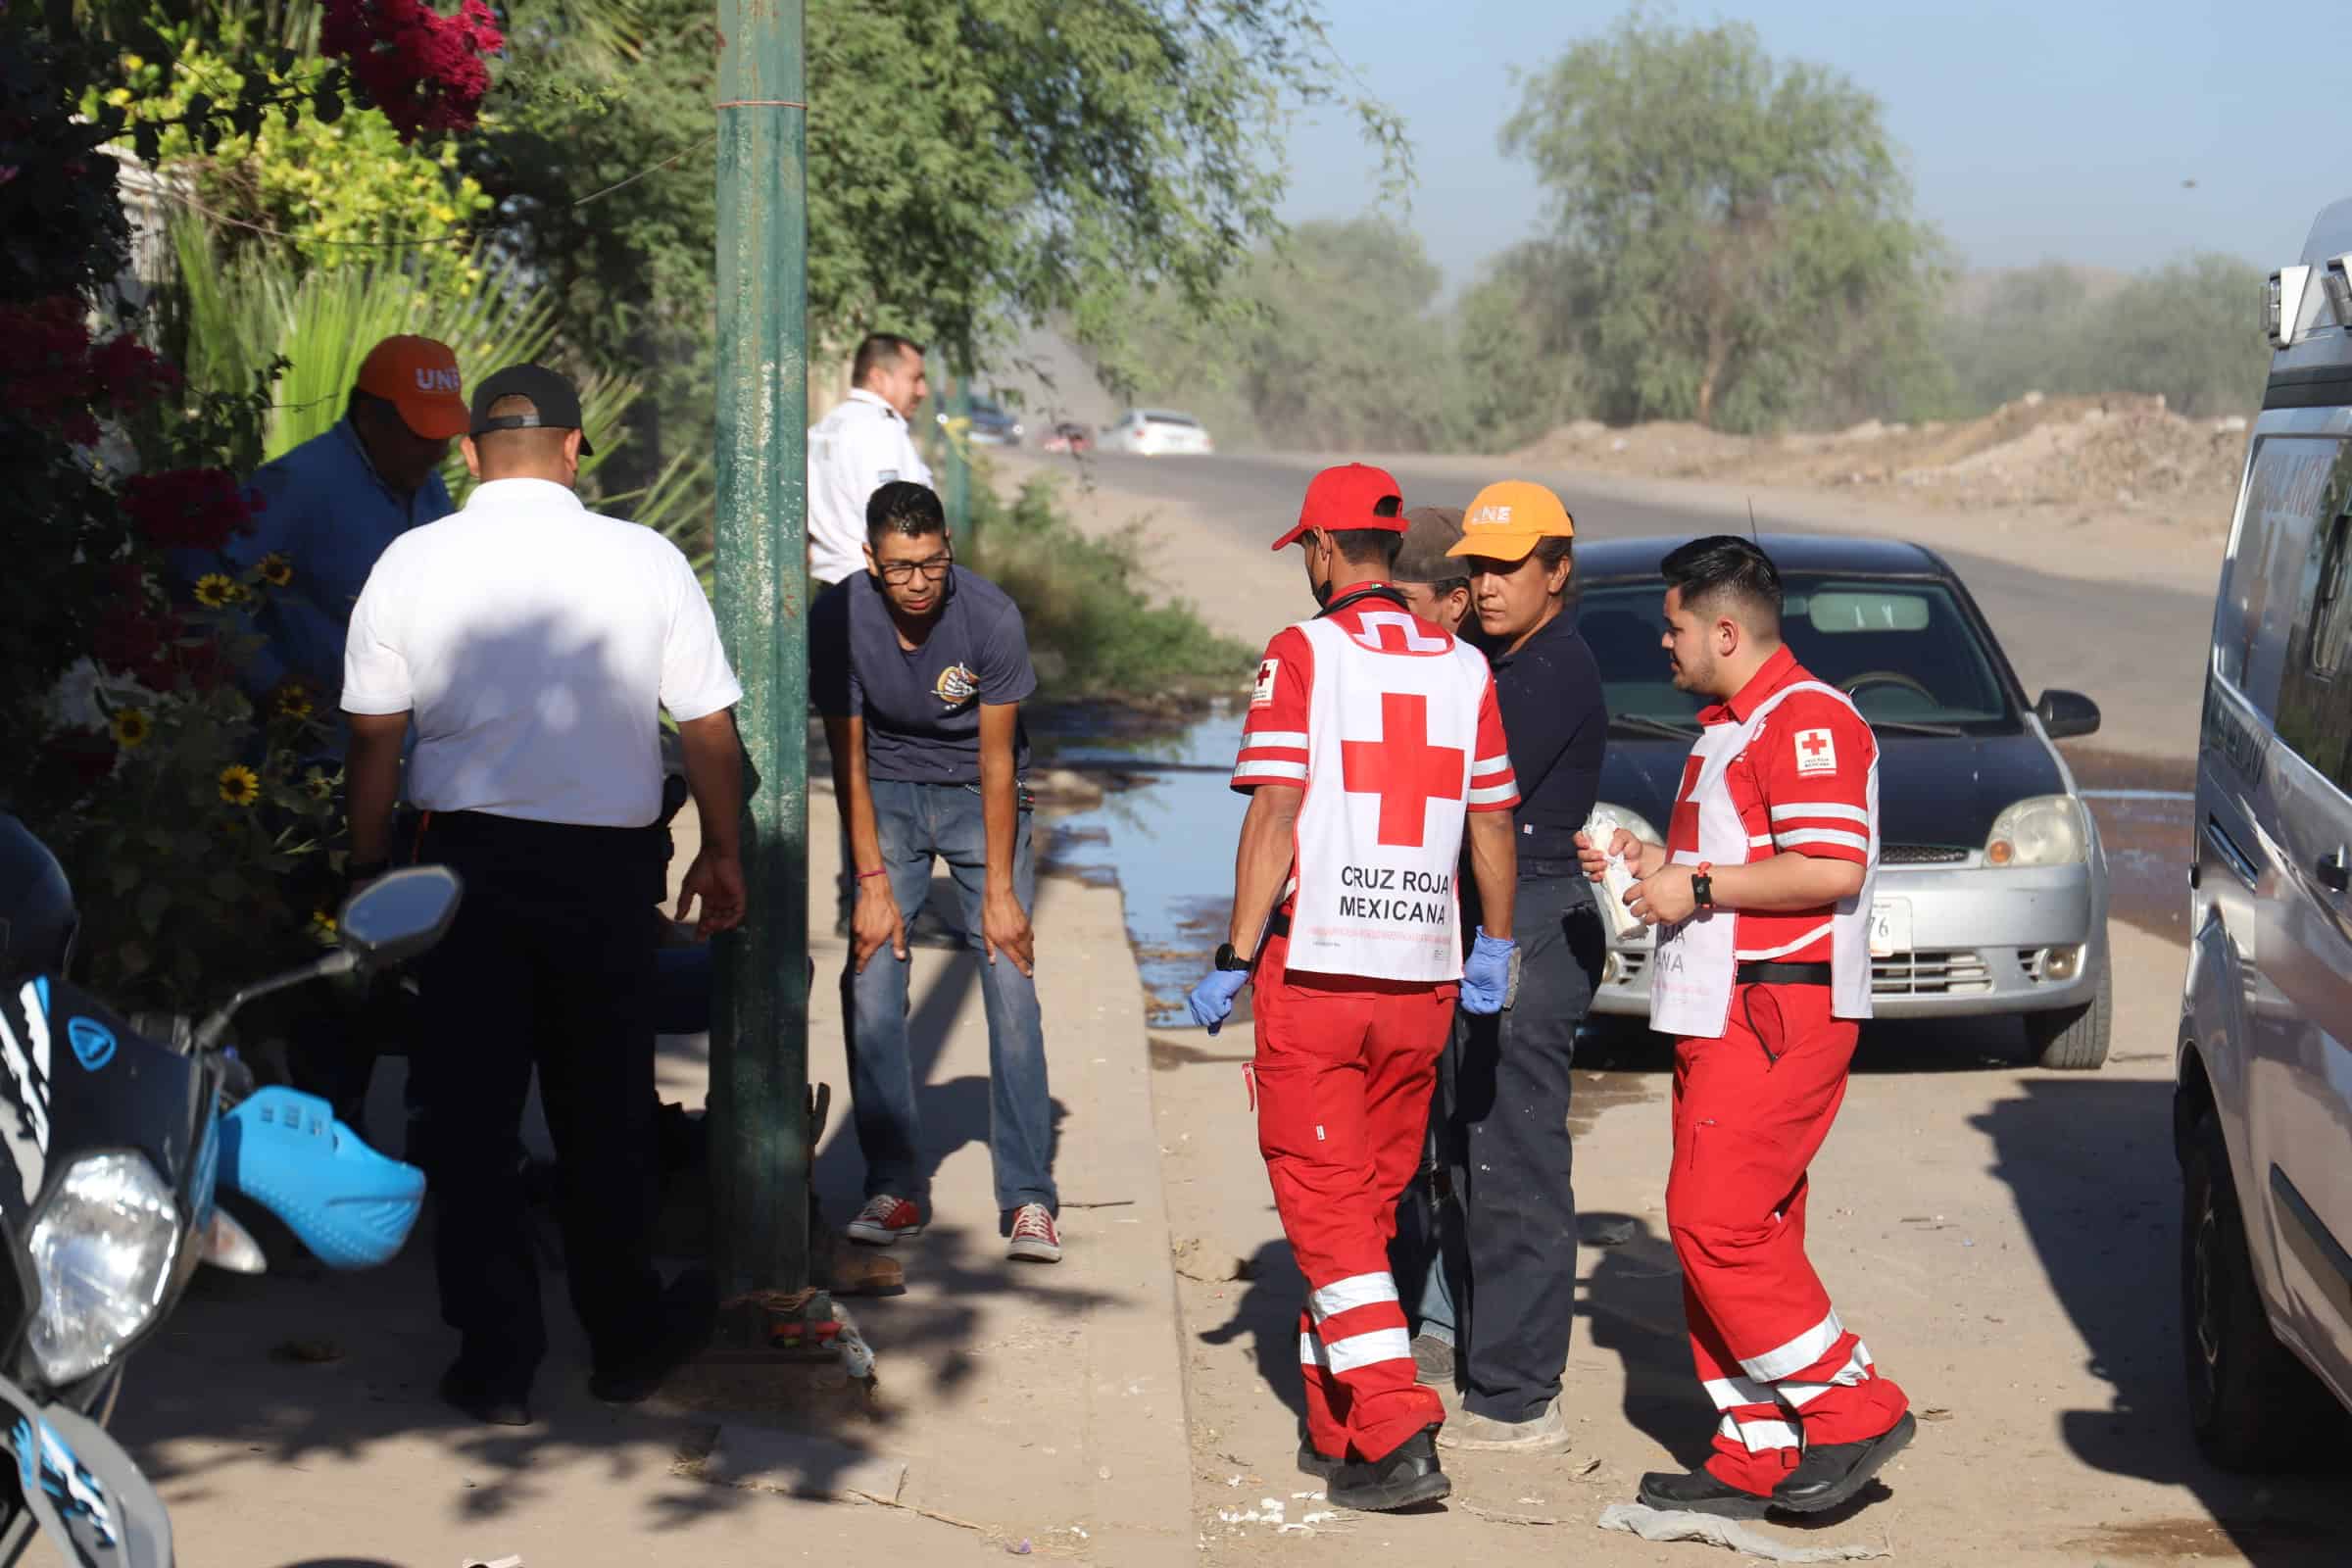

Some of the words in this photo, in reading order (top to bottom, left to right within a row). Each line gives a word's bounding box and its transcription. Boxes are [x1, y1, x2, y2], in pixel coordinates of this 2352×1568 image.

[1341, 865, 1396, 890] CRUZ
[1402, 870, 1449, 895] ROJA
[1340, 895, 1445, 925] MEXICANA
